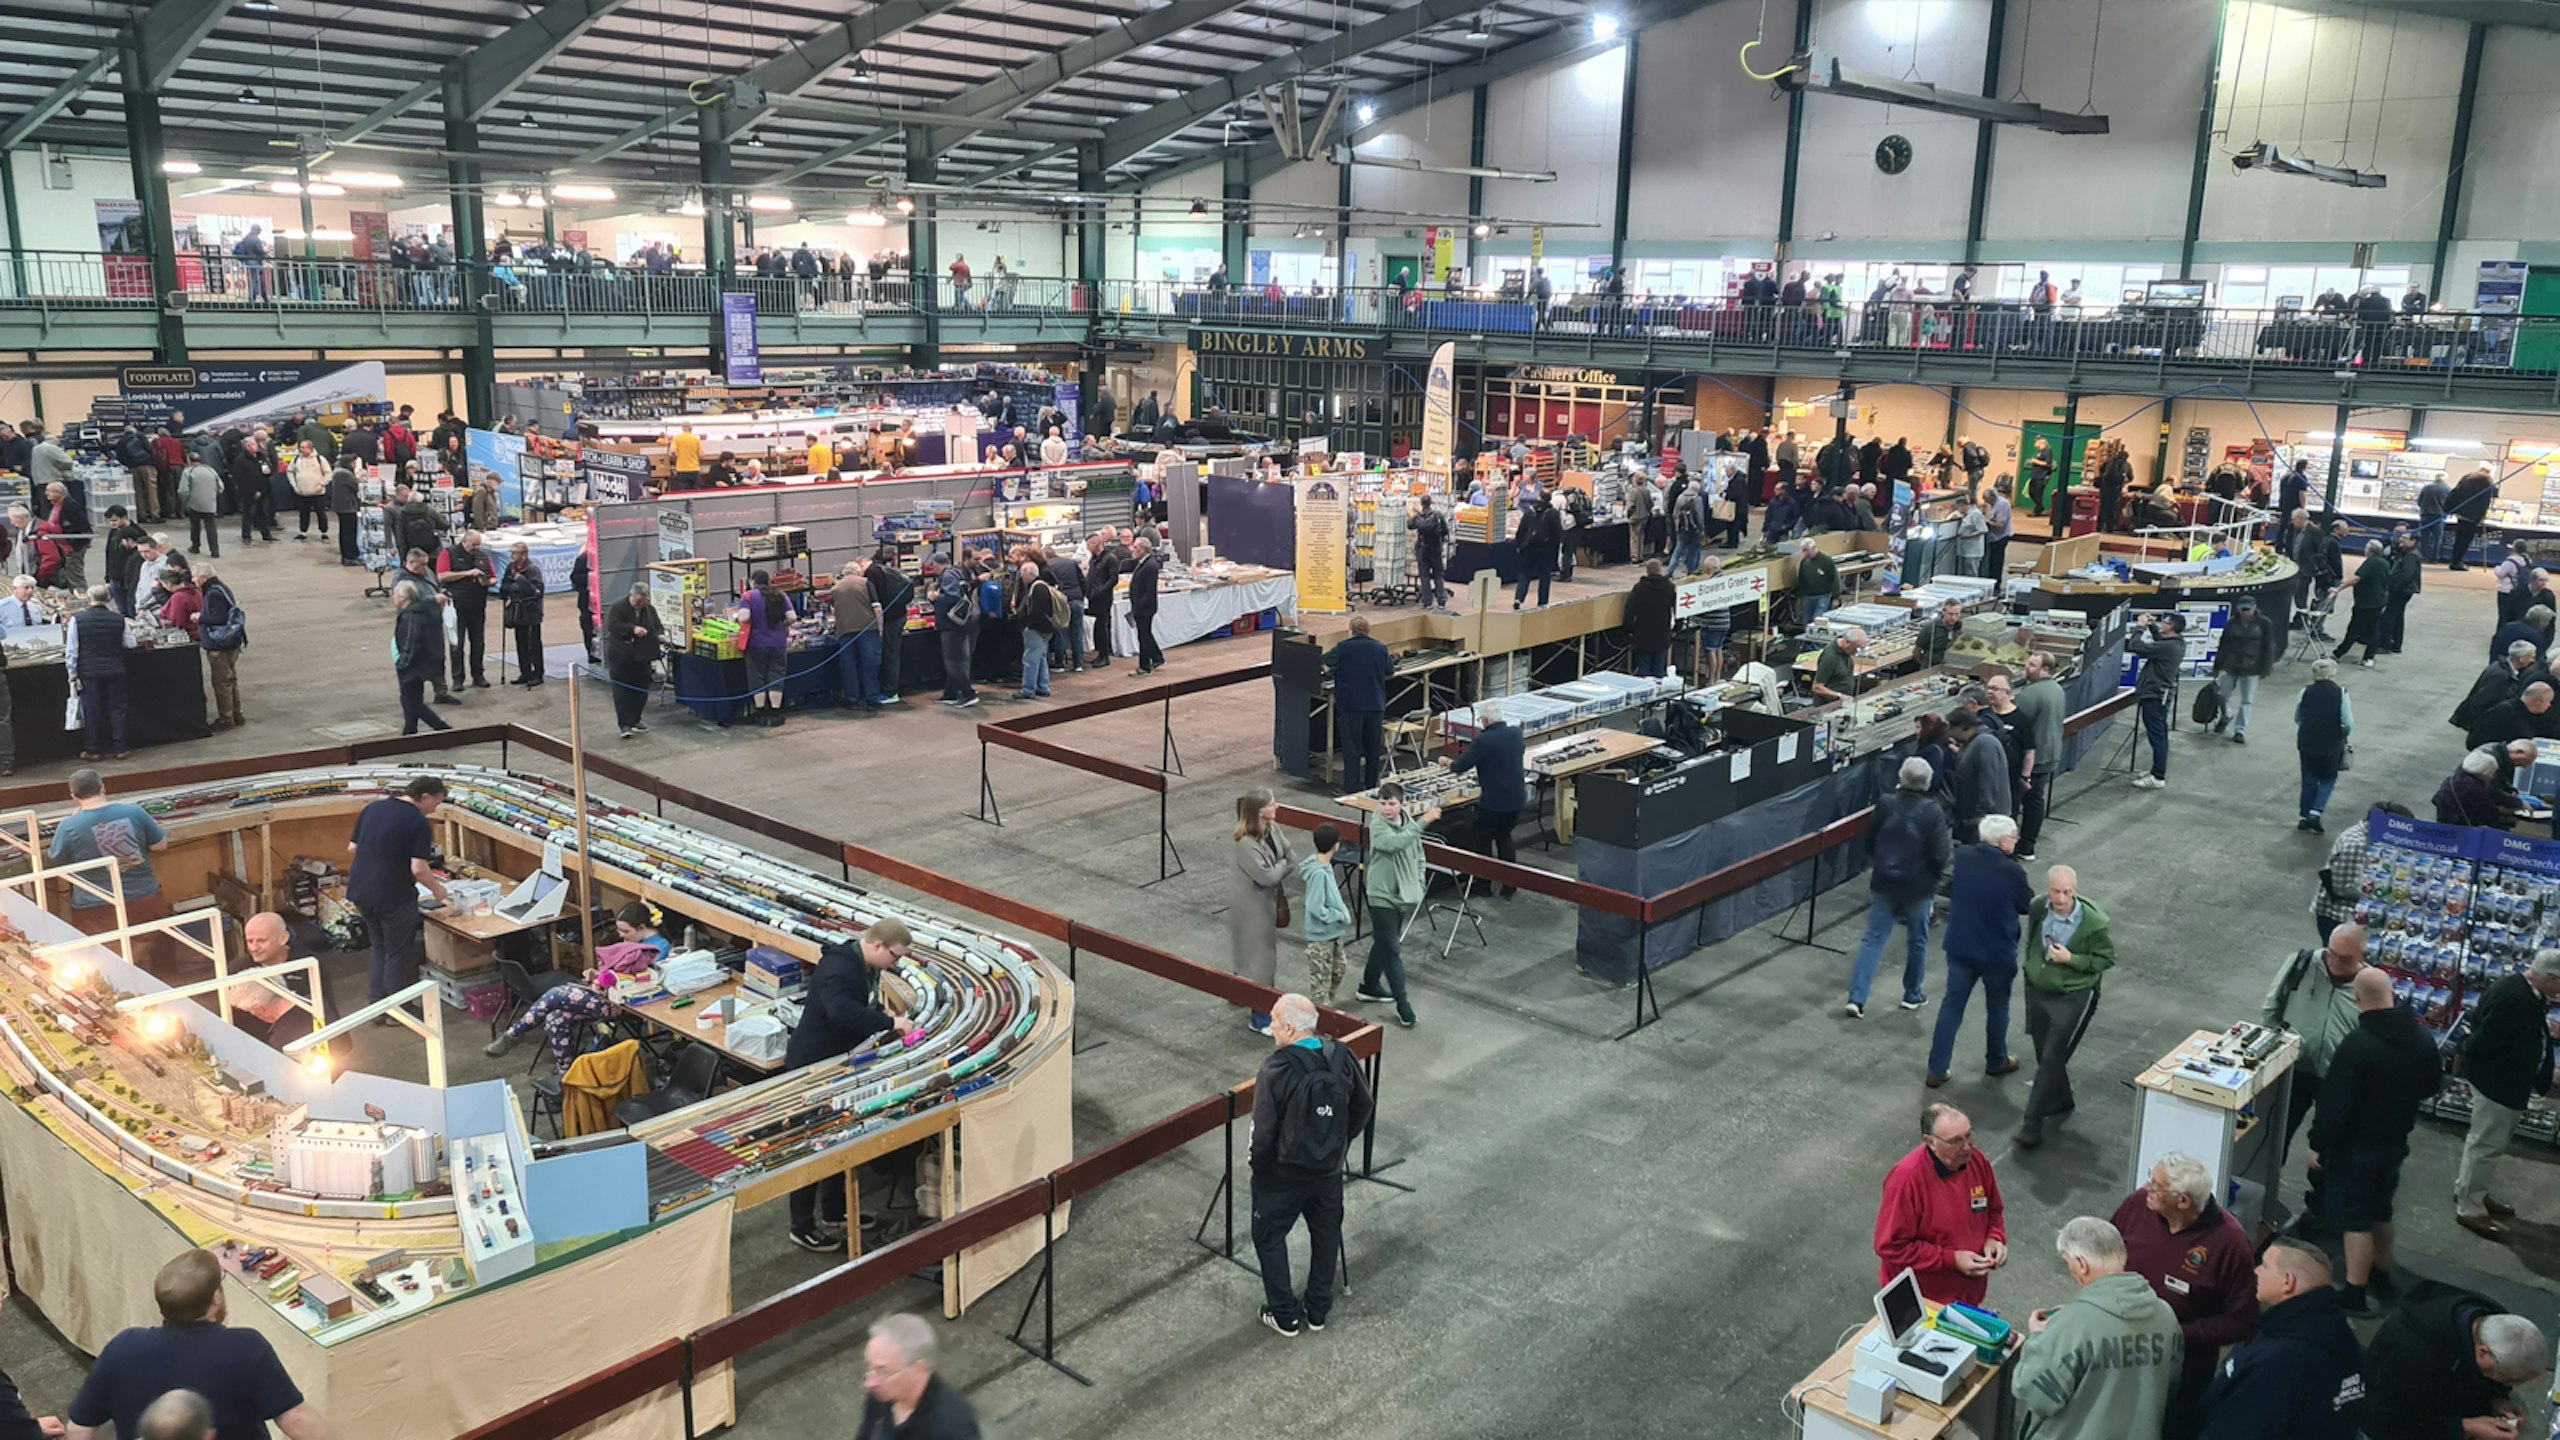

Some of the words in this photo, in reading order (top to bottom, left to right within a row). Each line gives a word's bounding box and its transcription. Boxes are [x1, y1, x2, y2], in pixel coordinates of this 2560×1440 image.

[1201, 331, 1294, 356] BINGLEY
[1302, 337, 1366, 359] ARMS
[129, 372, 191, 383] FOOTPLATE
[1577, 369, 1617, 385] Office
[127, 392, 162, 401] Looking
[164, 392, 174, 400] to
[176, 391, 189, 400] sell
[191, 392, 210, 401] your
[211, 390, 246, 400] models?
[602, 454, 623, 468] LEARN
[627, 458, 648, 470] SHOP
[596, 474, 627, 493] Model
[544, 556, 575, 570] Mod
[544, 571, 571, 584] Wor
[1697, 582, 1725, 596] Blowers
[1727, 577, 1748, 589] Green
[1718, 596, 1733, 605] Repair
[2387, 819, 2414, 833] DMG
[2503, 838, 2531, 852] DMG
